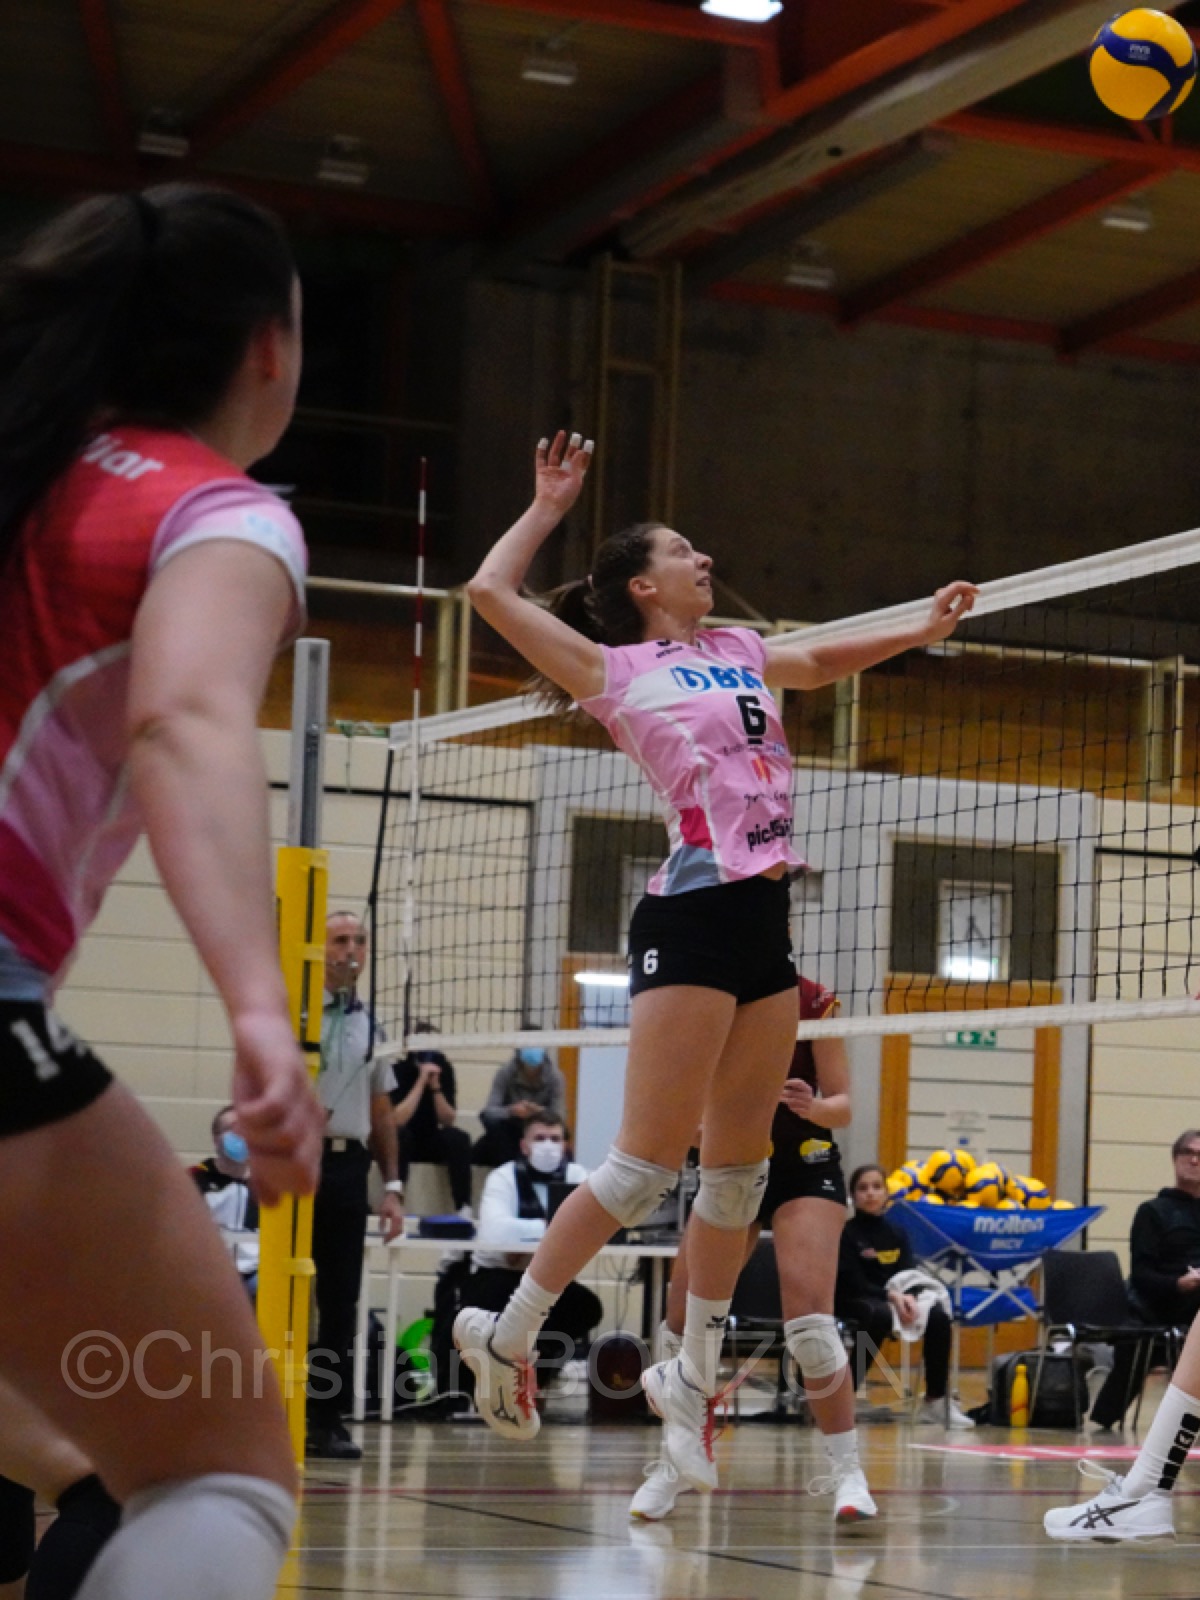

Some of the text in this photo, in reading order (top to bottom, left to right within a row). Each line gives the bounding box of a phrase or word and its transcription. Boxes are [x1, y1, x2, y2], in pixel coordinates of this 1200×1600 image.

[736, 695, 767, 735] 6
[643, 947, 659, 975] 6
[973, 1213, 1045, 1234] molten
